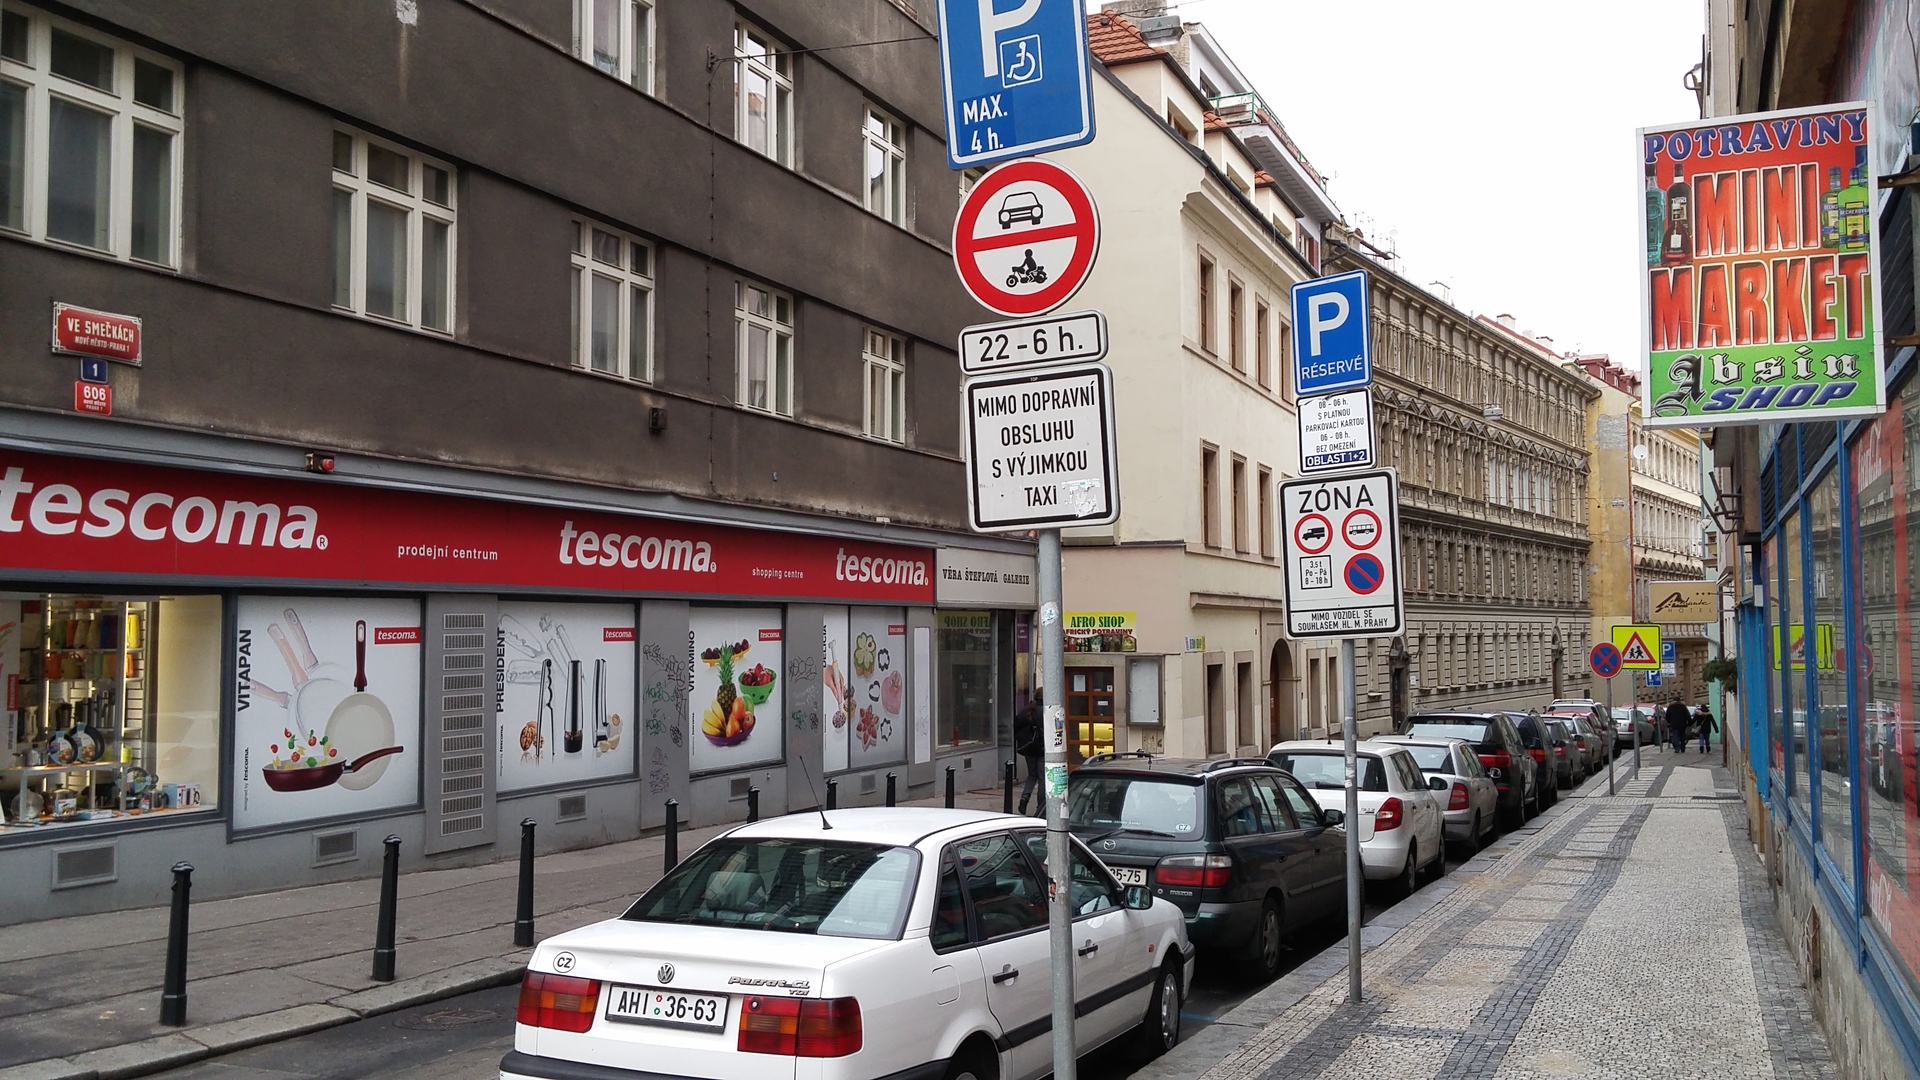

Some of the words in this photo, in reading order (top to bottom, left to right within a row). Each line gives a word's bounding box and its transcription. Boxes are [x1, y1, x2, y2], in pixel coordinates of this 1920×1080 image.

[978, 0, 1042, 78] P
[963, 94, 1008, 125] MAX.
[971, 130, 982, 153] 4
[988, 127, 1004, 150] h.
[1644, 112, 1868, 164] POTRAVINY
[1692, 162, 1821, 259] MINI
[1648, 251, 1870, 352] MARKET
[67, 318, 80, 332] VE
[85, 321, 134, 343] SMEČKÁCH
[1308, 291, 1350, 357] P
[75, 336, 89, 344] NOVÉ
[127, 345, 130, 353] 1
[1058, 326, 1083, 351] h.
[93, 363, 98, 377] 1
[1301, 354, 1363, 380] RÉSERVÉ
[83, 386, 106, 401] 606
[978, 394, 1017, 418] MIMO
[1022, 380, 1095, 413] DOPRAVNÍ
[1701, 381, 1858, 412] SHOP
[1306, 420, 1339, 432] PARKOVACÍ
[1341, 418, 1364, 428] KARTOU
[1318, 412, 1322, 420] S
[1324, 408, 1350, 419] PLATNOU
[1001, 419, 1074, 446] OBSLUHU
[1307, 453, 1346, 466] OBLAST
[1349, 451, 1365, 461] 1+2
[1316, 445, 1327, 453] BEZ
[1329, 439, 1356, 451] OMEZENÍ
[992, 459, 1001, 478] S
[1007, 450, 1088, 477] VÝJIMKOU
[1024, 485, 1057, 507] TAXI
[1299, 483, 1374, 513] ZÓNA
[398, 544, 449, 559] prodejní
[452, 548, 498, 560] centrum
[752, 567, 782, 579] shopping
[784, 569, 804, 579] centre
[942, 566, 962, 581] VĚRA
[1003, 574, 1029, 585] GALERIE
[1071, 616, 1095, 627] AFRO
[1099, 616, 1124, 627] SHOP
[1311, 612, 1330, 621] MIMO
[1333, 610, 1360, 619] VOZIDEL
[1364, 610, 1372, 618] SE
[1342, 620, 1353, 629] HL.
[1355, 620, 1363, 628] M.
[1364, 618, 1388, 627] PRAHY
[1662, 643, 1671, 655] P
[238, 629, 251, 712] VITAPAN
[496, 628, 505, 713] PRESIDENT
[556, 956, 572, 969] CZ
[618, 990, 649, 1015] AHI
[665, 995, 716, 1022] 36-63
